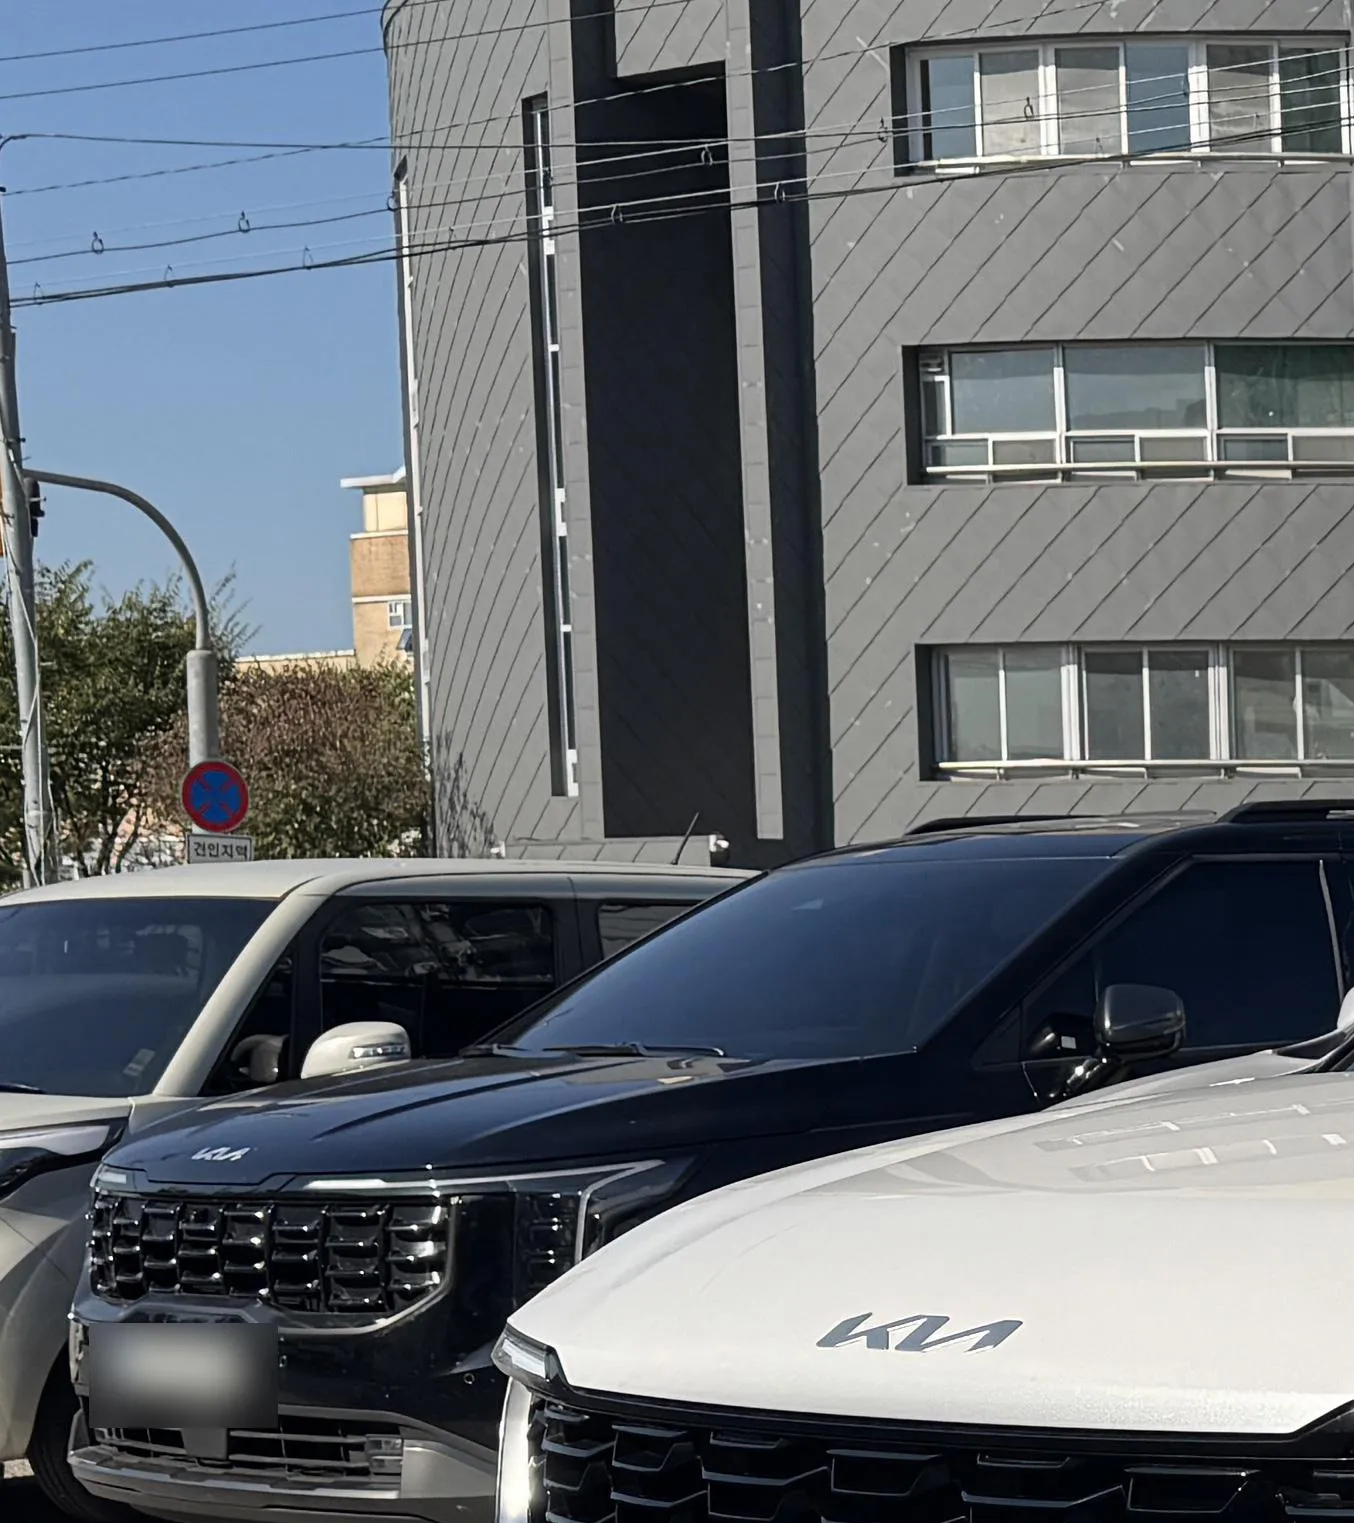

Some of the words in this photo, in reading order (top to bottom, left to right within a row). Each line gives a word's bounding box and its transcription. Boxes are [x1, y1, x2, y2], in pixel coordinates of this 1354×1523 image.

[193, 840, 248, 860] 견인지역
[191, 1146, 251, 1161] KIA
[815, 1311, 1024, 1353] KIA
